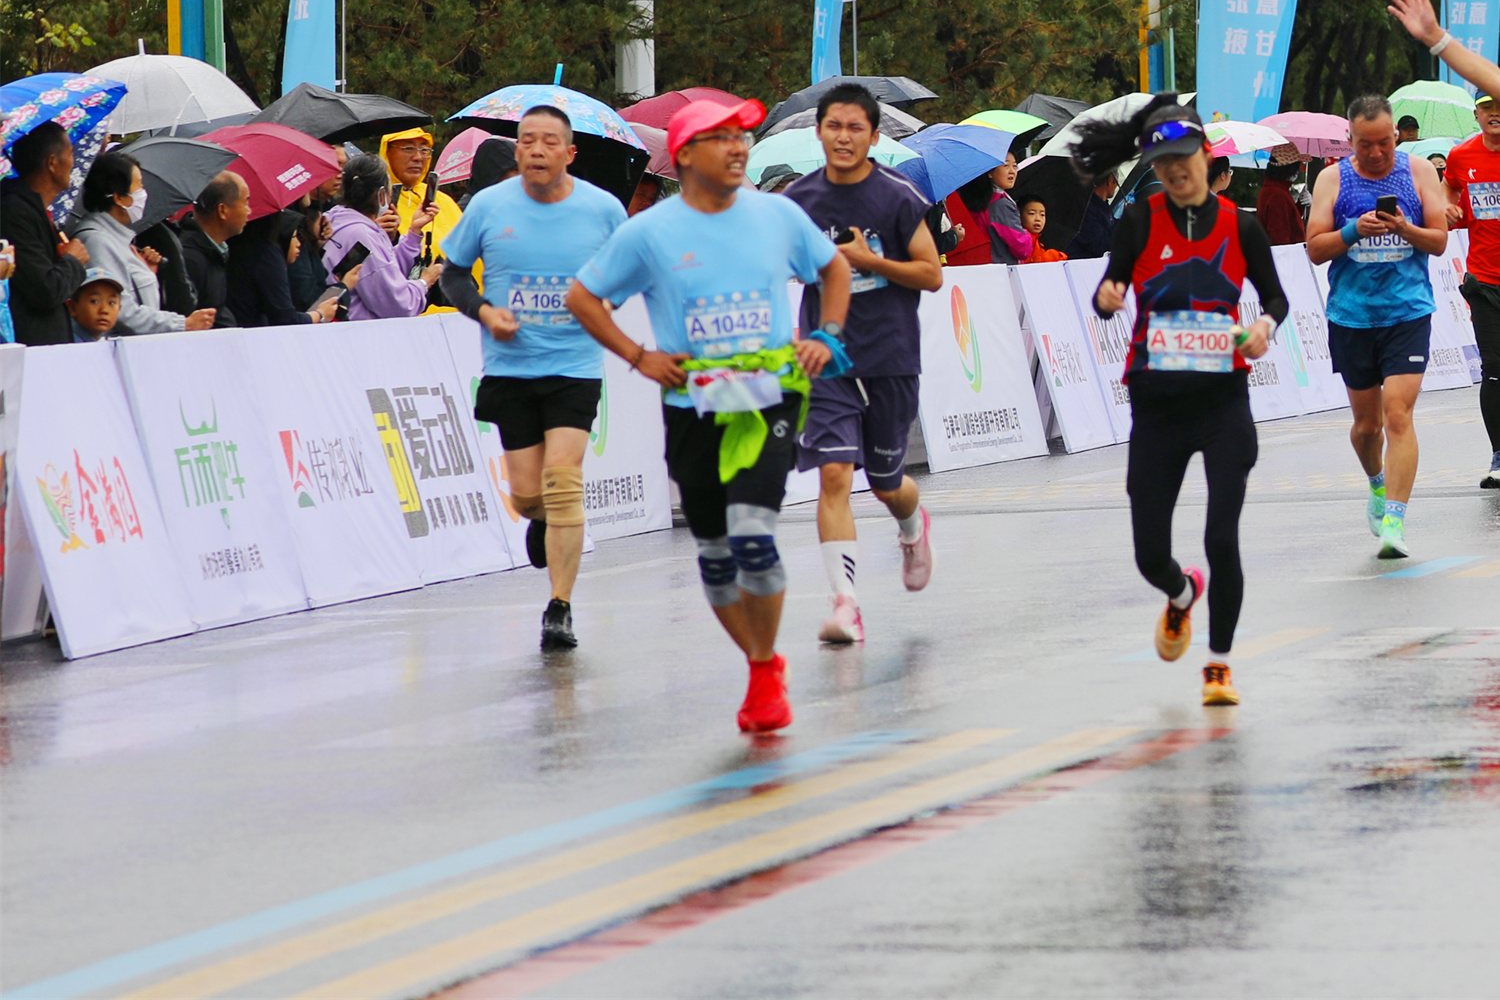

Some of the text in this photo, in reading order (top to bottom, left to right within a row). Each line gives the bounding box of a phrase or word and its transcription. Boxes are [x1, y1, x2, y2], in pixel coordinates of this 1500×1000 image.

[1472, 195, 1481, 207] A
[511, 290, 567, 308] A 106
[690, 311, 770, 337] A 10424
[1151, 329, 1229, 351] A 12100
